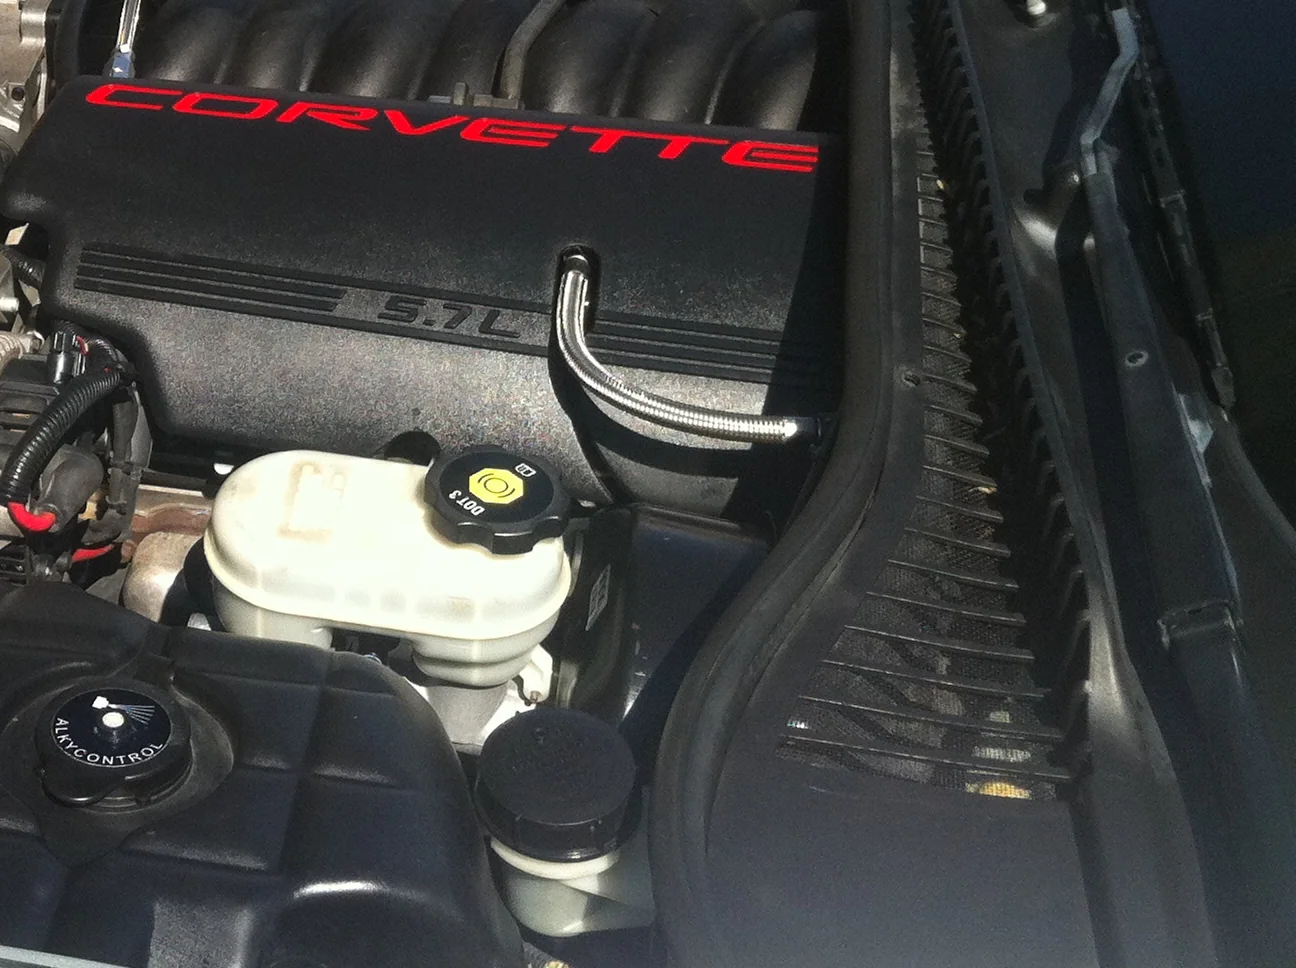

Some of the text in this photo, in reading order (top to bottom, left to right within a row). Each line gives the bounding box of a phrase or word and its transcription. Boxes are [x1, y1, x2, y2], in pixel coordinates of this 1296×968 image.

[85, 83, 820, 172] CORVETTE
[377, 295, 521, 339] 5.7L
[449, 490, 485, 516] DOT 3
[55, 717, 164, 766] ALKYCONTROL
